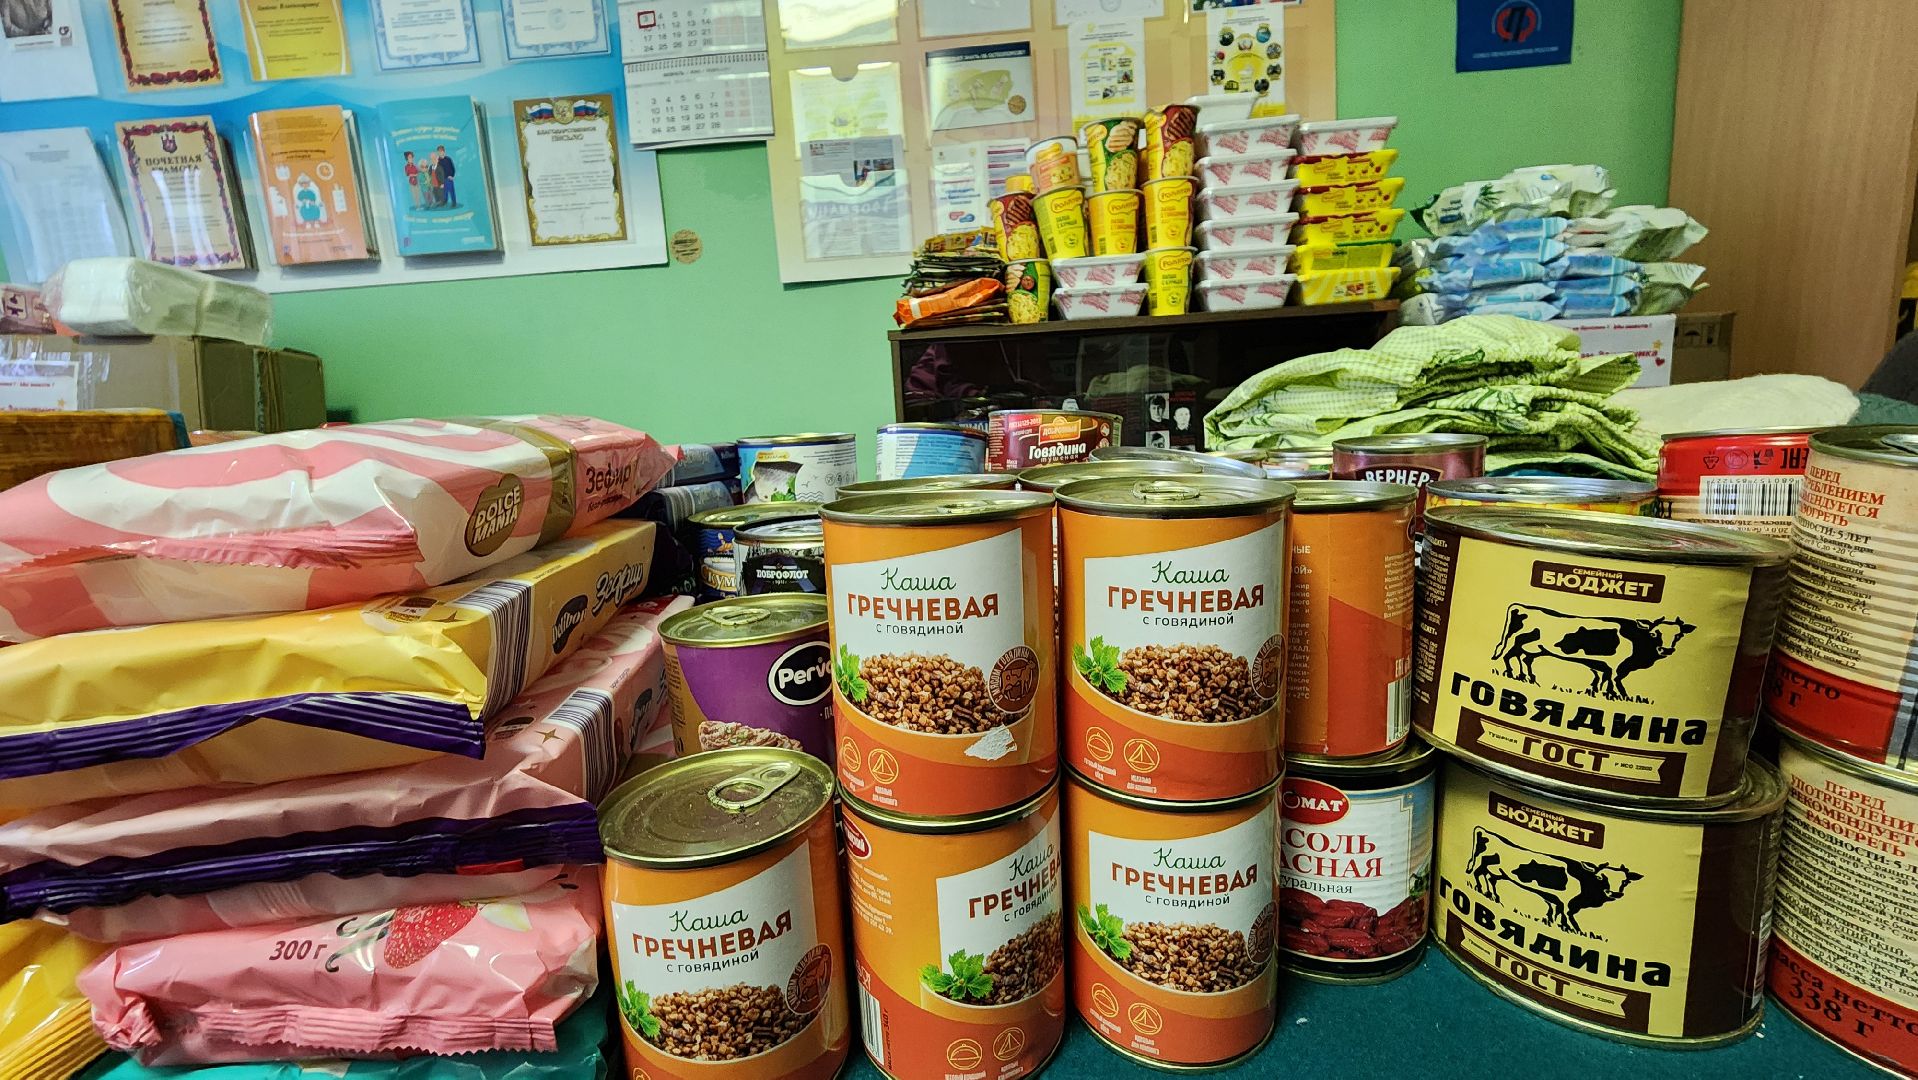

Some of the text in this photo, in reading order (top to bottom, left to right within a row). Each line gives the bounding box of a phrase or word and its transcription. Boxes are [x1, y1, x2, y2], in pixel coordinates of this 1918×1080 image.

[687, 39, 697, 47] 27
[710, 111, 719, 119] 21
[1029, 442, 1087, 460] Говядина
[585, 463, 632, 495] Зефир
[1809, 465, 1842, 485] ПЕРЕД
[1800, 489, 1880, 520] МЕНДУЕТСЯ
[1805, 476, 1887, 506] РЕБЛЕНИЕМ
[475, 484, 521, 529] DOLCE
[1799, 502, 1849, 527] ЗОГРЕТЬ
[473, 504, 518, 545] MANIA
[1844, 531, 1872, 545] ЛЕТ
[700, 563, 737, 590] СКУМ
[756, 568, 809, 580] ДОБРОФЛОТ
[880, 567, 957, 591] Каша
[1151, 560, 1230, 585] Каша
[1541, 570, 1654, 599] БЮДЖЕТ
[1572, 567, 1623, 580] СЕМЕЙНЫЙ
[847, 593, 999, 622] ГРЕЧНЕВАЯ
[1108, 584, 1264, 614] ГРЕЧНЕВАЯ
[886, 620, 964, 637] говядиной
[1155, 612, 1235, 629] говядиной
[1521, 736, 1611, 773] ГОСТ
[1791, 774, 1918, 835] УПОТРЕБЛЕНИ
[1824, 779, 1886, 814] ПЕРЕД
[1496, 802, 1595, 844] БЮДЖЕТ
[1519, 804, 1566, 823] СЕМЕЙНЫЙ
[1806, 809, 1906, 858] РАЗОГРЕТЬ
[1153, 846, 1227, 870] Каша
[1280, 849, 1384, 878] АСНАЯ
[1111, 862, 1258, 896] ГРЕЧНЕВАЯ
[1156, 893, 1231, 910] говядиной
[669, 908, 749, 933] Каша
[632, 910, 793, 961] ГРЕЧНЕВАЯ
[269, 940, 328, 960] 300 г
[678, 948, 760, 974] говядиной
[1494, 949, 1571, 997] ГОСТ
[1789, 976, 1842, 1022] 338
